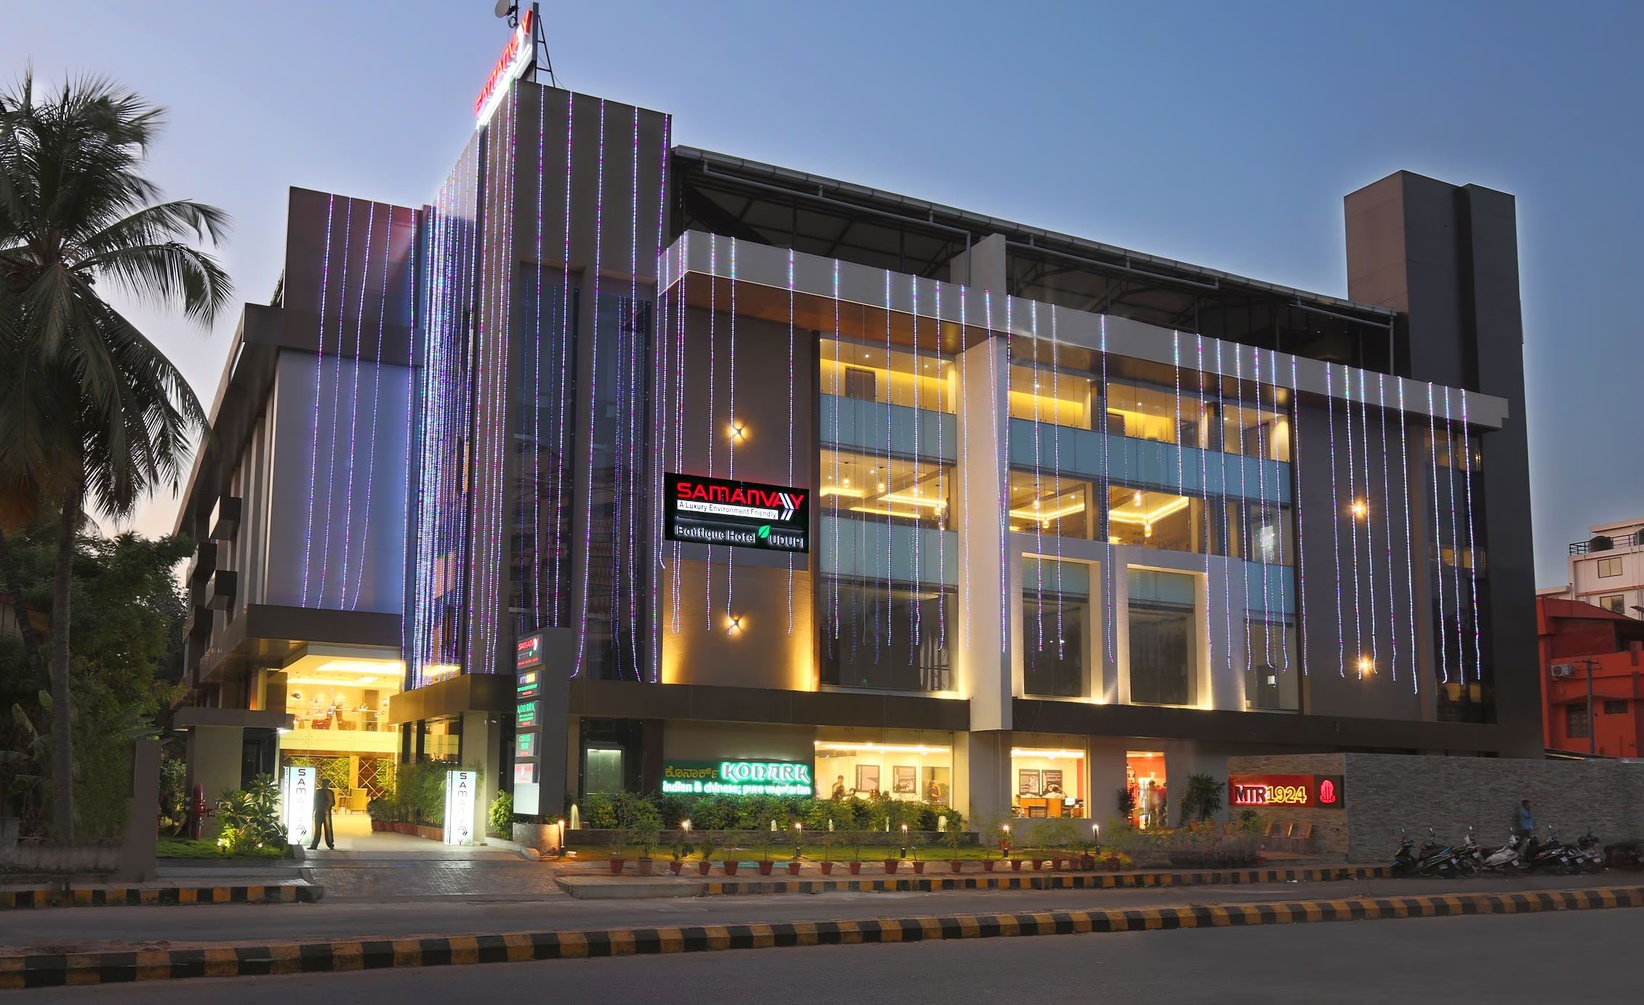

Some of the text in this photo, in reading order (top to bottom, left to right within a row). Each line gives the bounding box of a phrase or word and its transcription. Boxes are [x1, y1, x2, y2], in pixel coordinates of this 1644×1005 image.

[677, 482, 805, 509] SAMANVAY
[679, 499, 777, 519] A Luxury Environment Friendly
[675, 525, 725, 541] Boutique
[726, 530, 756, 544] Hotel
[722, 762, 811, 783] KONARK
[694, 781, 703, 793] &
[743, 784, 764, 796] pure
[764, 784, 811, 796] vegetarian
